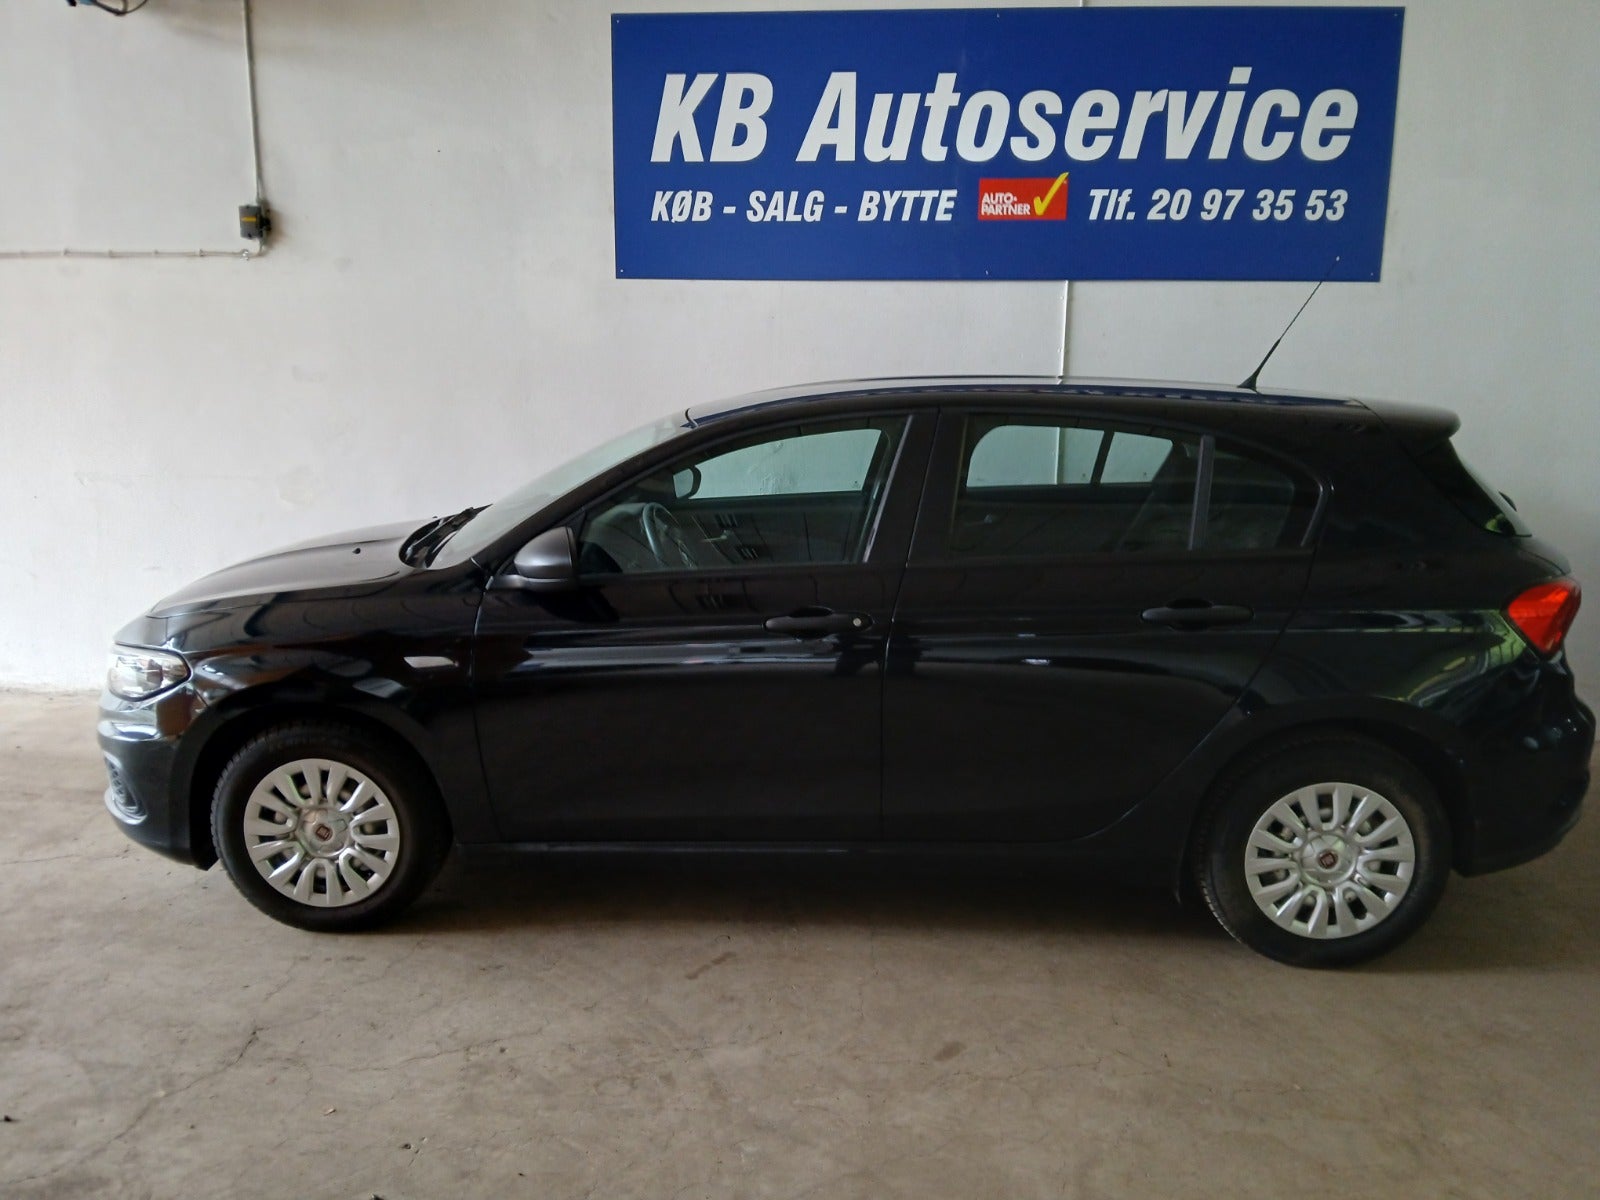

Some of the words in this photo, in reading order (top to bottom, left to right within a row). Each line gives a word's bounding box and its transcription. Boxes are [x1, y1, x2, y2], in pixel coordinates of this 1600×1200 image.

[651, 72, 773, 163] KB
[796, 66, 1358, 163] Autoservice
[651, 189, 713, 224] KØB
[746, 190, 825, 223] SALG
[857, 189, 958, 222] BYTTE
[981, 203, 1031, 216] PARTNER
[1089, 188, 1136, 221] Tlf.
[1147, 188, 1192, 221] 20
[1201, 188, 1245, 221] 97
[1253, 188, 1296, 221] 35
[1305, 189, 1348, 221] 53
